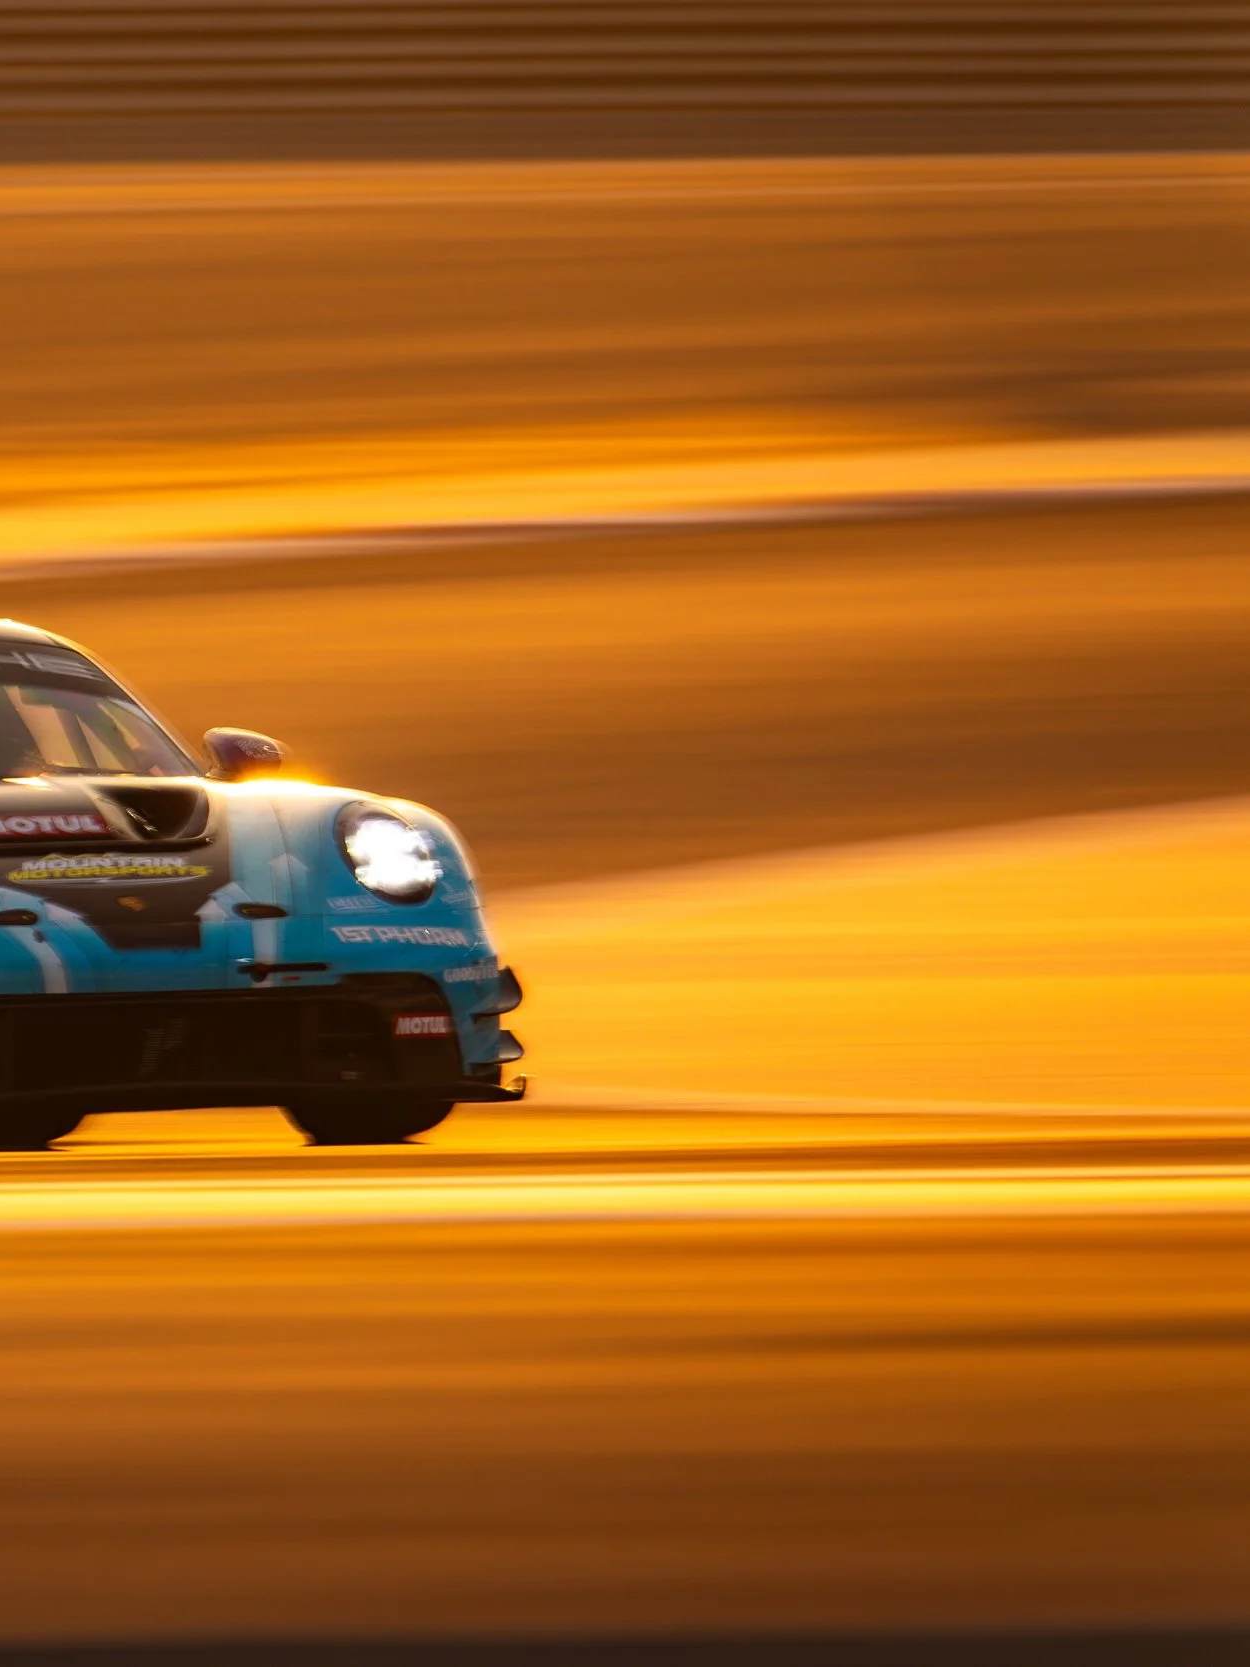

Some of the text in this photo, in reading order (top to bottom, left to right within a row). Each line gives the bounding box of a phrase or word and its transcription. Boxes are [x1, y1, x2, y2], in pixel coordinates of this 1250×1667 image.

[21, 857, 186, 871] MOUNTAIN
[8, 866, 208, 880] MOTORSPORTS
[396, 1016, 446, 1034] MOTUL
